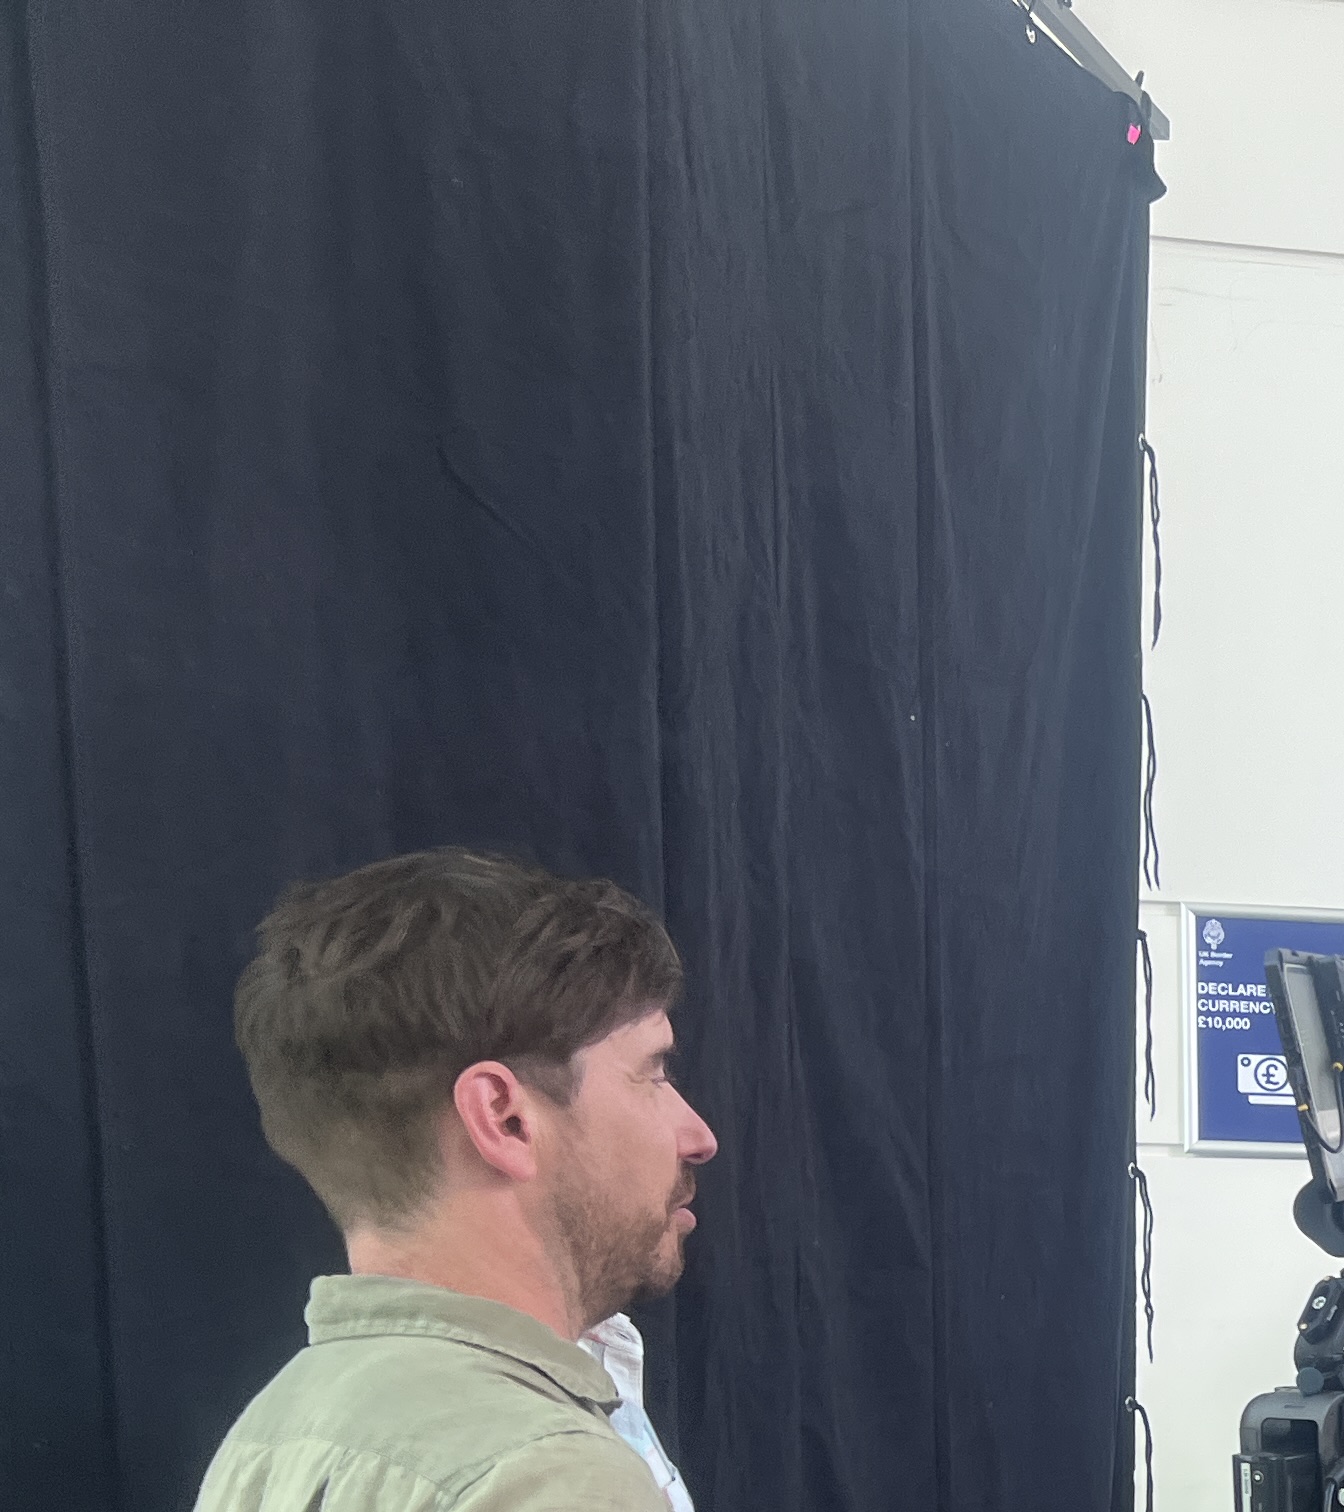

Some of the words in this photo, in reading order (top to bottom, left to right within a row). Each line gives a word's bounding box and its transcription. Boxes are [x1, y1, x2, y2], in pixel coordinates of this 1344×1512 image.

[1199, 959, 1224, 967] Agency
[1198, 982, 1266, 997] DECLARE
[1197, 1016, 1250, 1030] £10,000
